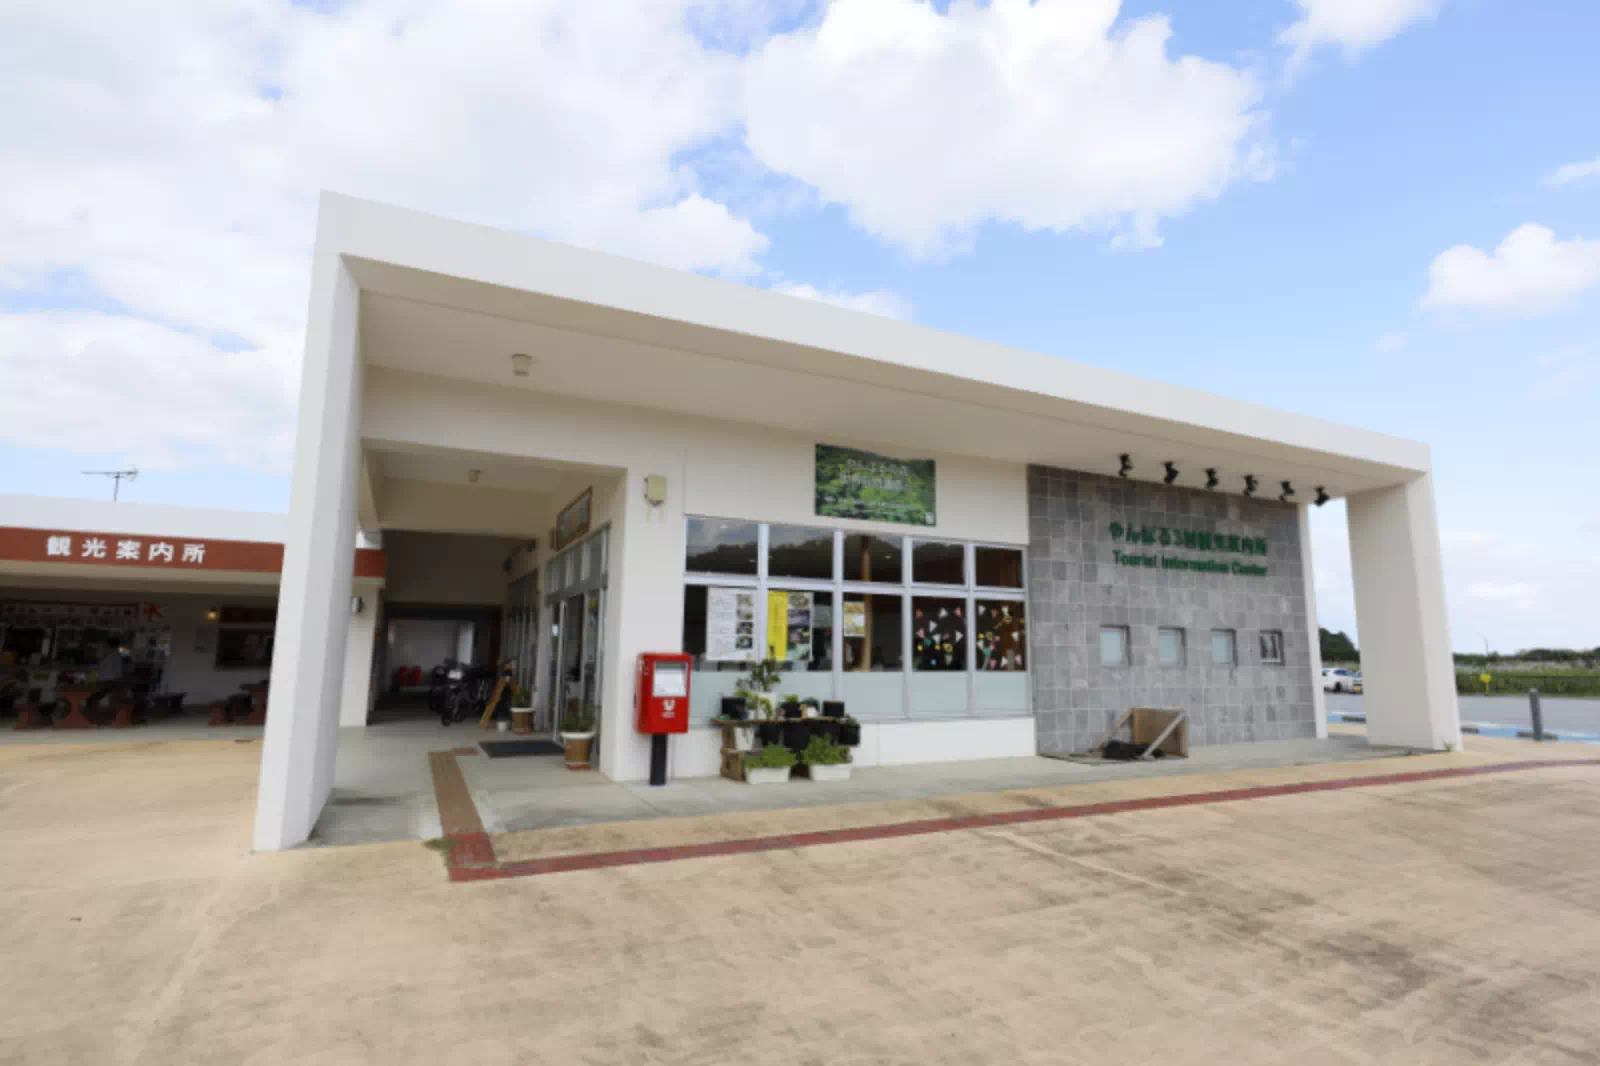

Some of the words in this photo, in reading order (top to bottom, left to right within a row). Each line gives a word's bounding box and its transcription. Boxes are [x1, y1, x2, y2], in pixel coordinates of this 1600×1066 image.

[46, 534, 206, 564] 観光案内所
[1112, 549, 1157, 568] Tourist
[1161, 554, 1229, 574] Information
[1231, 560, 1268, 577] Center
